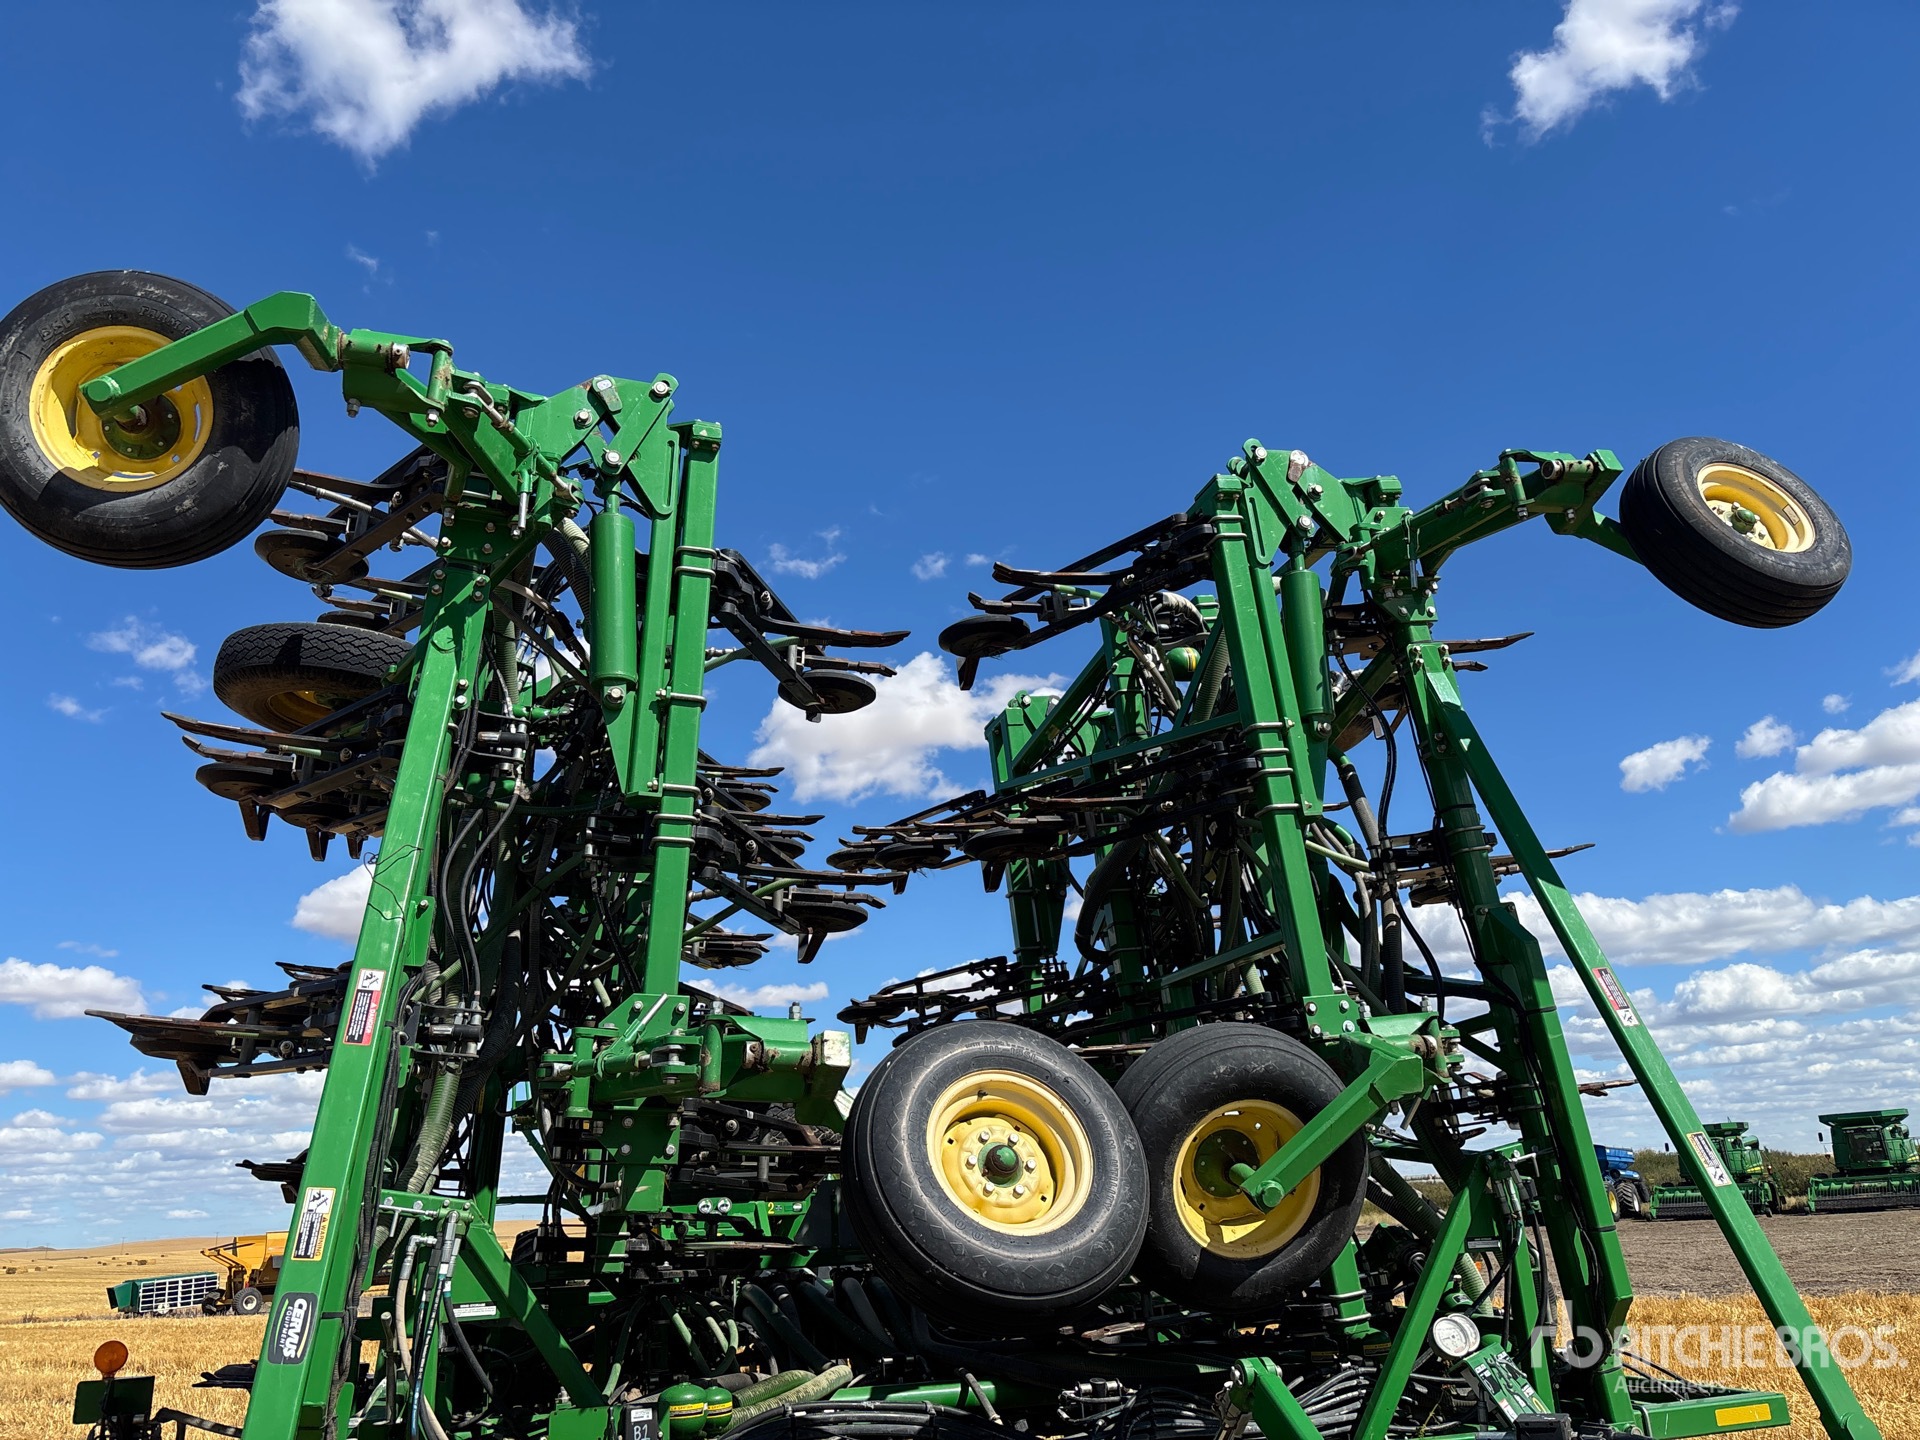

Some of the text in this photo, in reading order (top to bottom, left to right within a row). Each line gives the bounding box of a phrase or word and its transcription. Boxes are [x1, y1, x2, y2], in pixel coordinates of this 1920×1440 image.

[1097, 1113, 1119, 1213] FARM UTILITY
[767, 1202, 775, 1215] 2
[315, 1225, 327, 1257] WARNING
[278, 1306, 294, 1348] EQUIPMENT
[282, 1298, 308, 1359] CERVUS
[633, 1424, 651, 1440] B1
